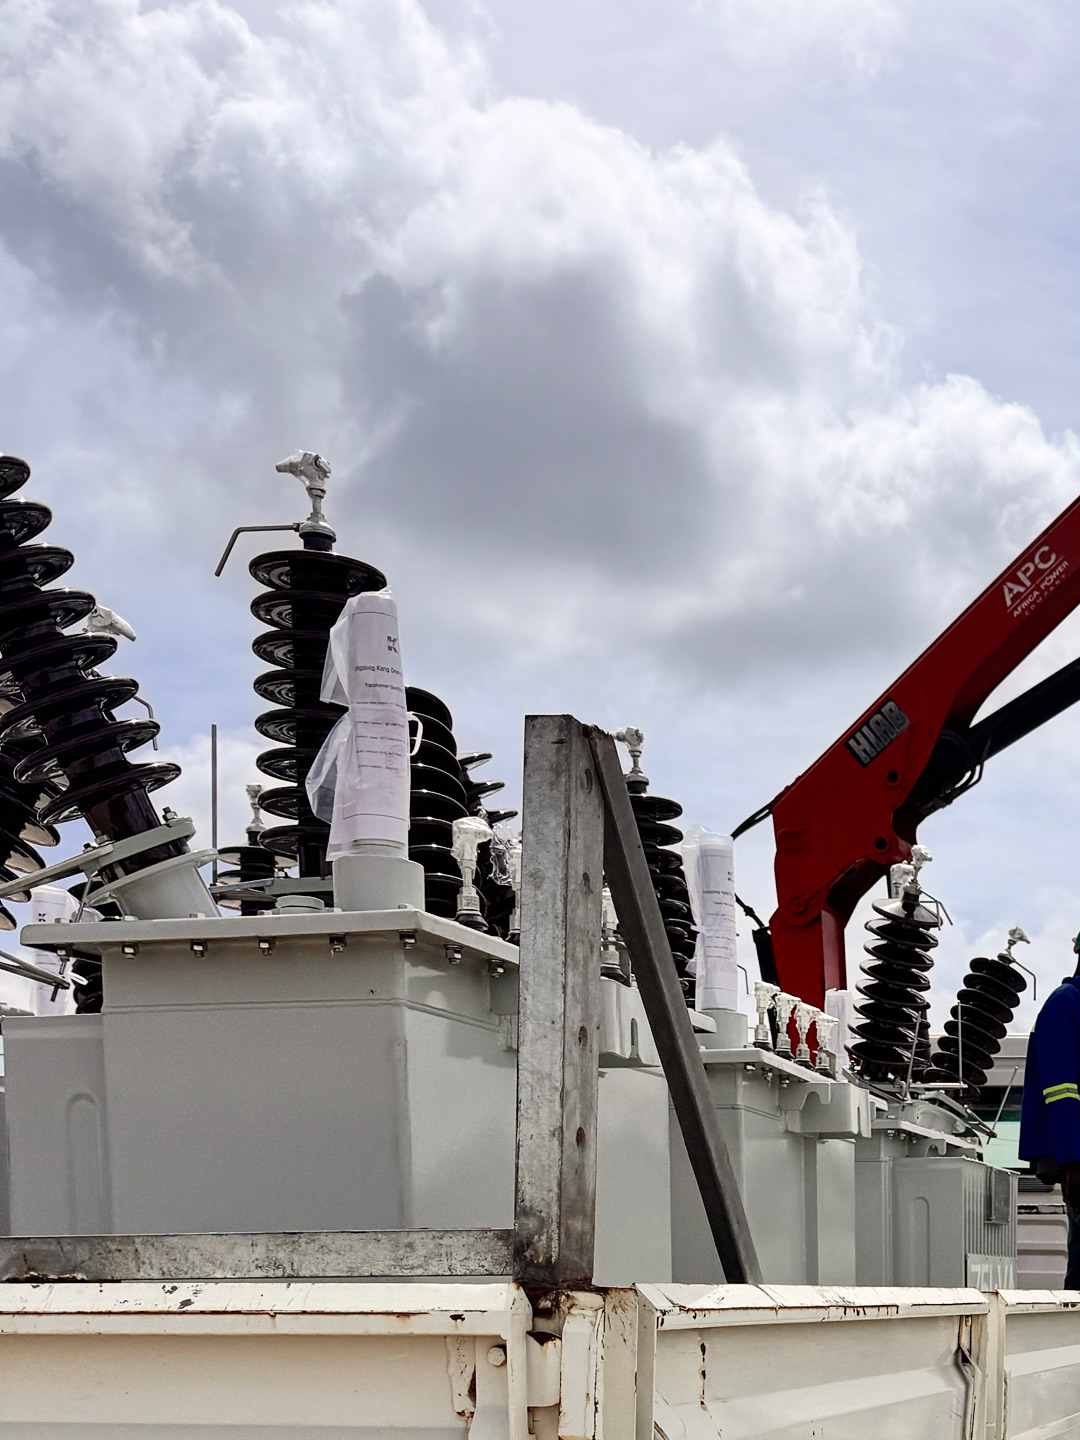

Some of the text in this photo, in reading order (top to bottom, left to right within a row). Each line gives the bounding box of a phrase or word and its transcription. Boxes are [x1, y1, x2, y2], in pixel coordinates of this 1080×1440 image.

[1003, 546, 1057, 608] APC
[1013, 560, 1069, 618] AFRICA POWER
[848, 701, 909, 765] HIAB
